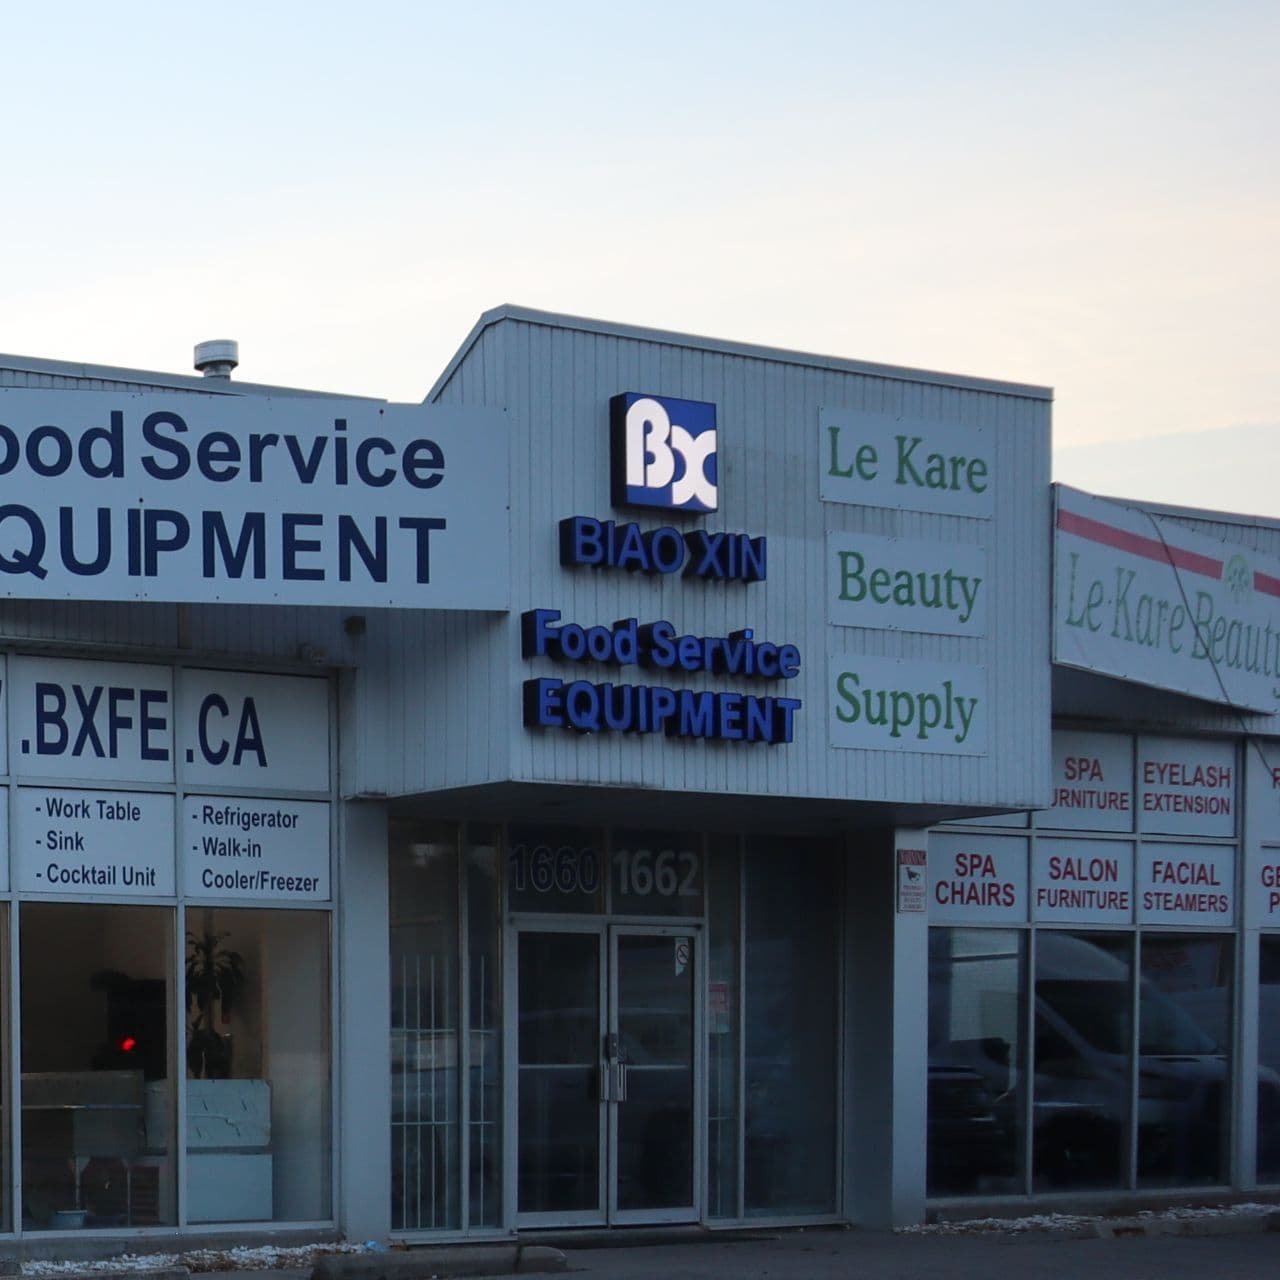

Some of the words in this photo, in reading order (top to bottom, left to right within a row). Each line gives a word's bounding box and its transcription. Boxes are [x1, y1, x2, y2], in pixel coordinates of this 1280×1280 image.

[827, 426, 878, 481] Le
[894, 435, 988, 494] Kare
[574, 517, 685, 573] BIAO
[696, 530, 766, 582] XIN
[837, 550, 983, 624] Beauty
[539, 610, 638, 664] Food
[650, 621, 801, 679] Service
[539, 679, 801, 743] EQUIPMENT
[835, 671, 979, 744] Supply
[1063, 755, 1104, 781] SPA
[1143, 760, 1231, 789] EYELASH
[45, 797, 91, 819] Work
[95, 799, 141, 822] Table
[1051, 787, 1130, 811] URNITURE
[1142, 792, 1231, 816] EXTENSION
[202, 805, 299, 831] Refrigerator
[46, 830, 85, 852] Sink
[201, 837, 262, 858] Walk-in
[46, 862, 117, 886] Cocktail
[122, 865, 156, 887] Unit
[510, 844, 600, 894] 1660
[612, 849, 700, 897] 1662
[954, 853, 997, 878] SPA
[1048, 856, 1118, 882] SALON
[1152, 860, 1221, 887] FACIAL
[201, 868, 320, 892] Cooler/Freezer
[934, 881, 1016, 908] CHAIRS
[1036, 887, 1130, 911] FURNITURE
[1142, 891, 1229, 914] STEAMERS
